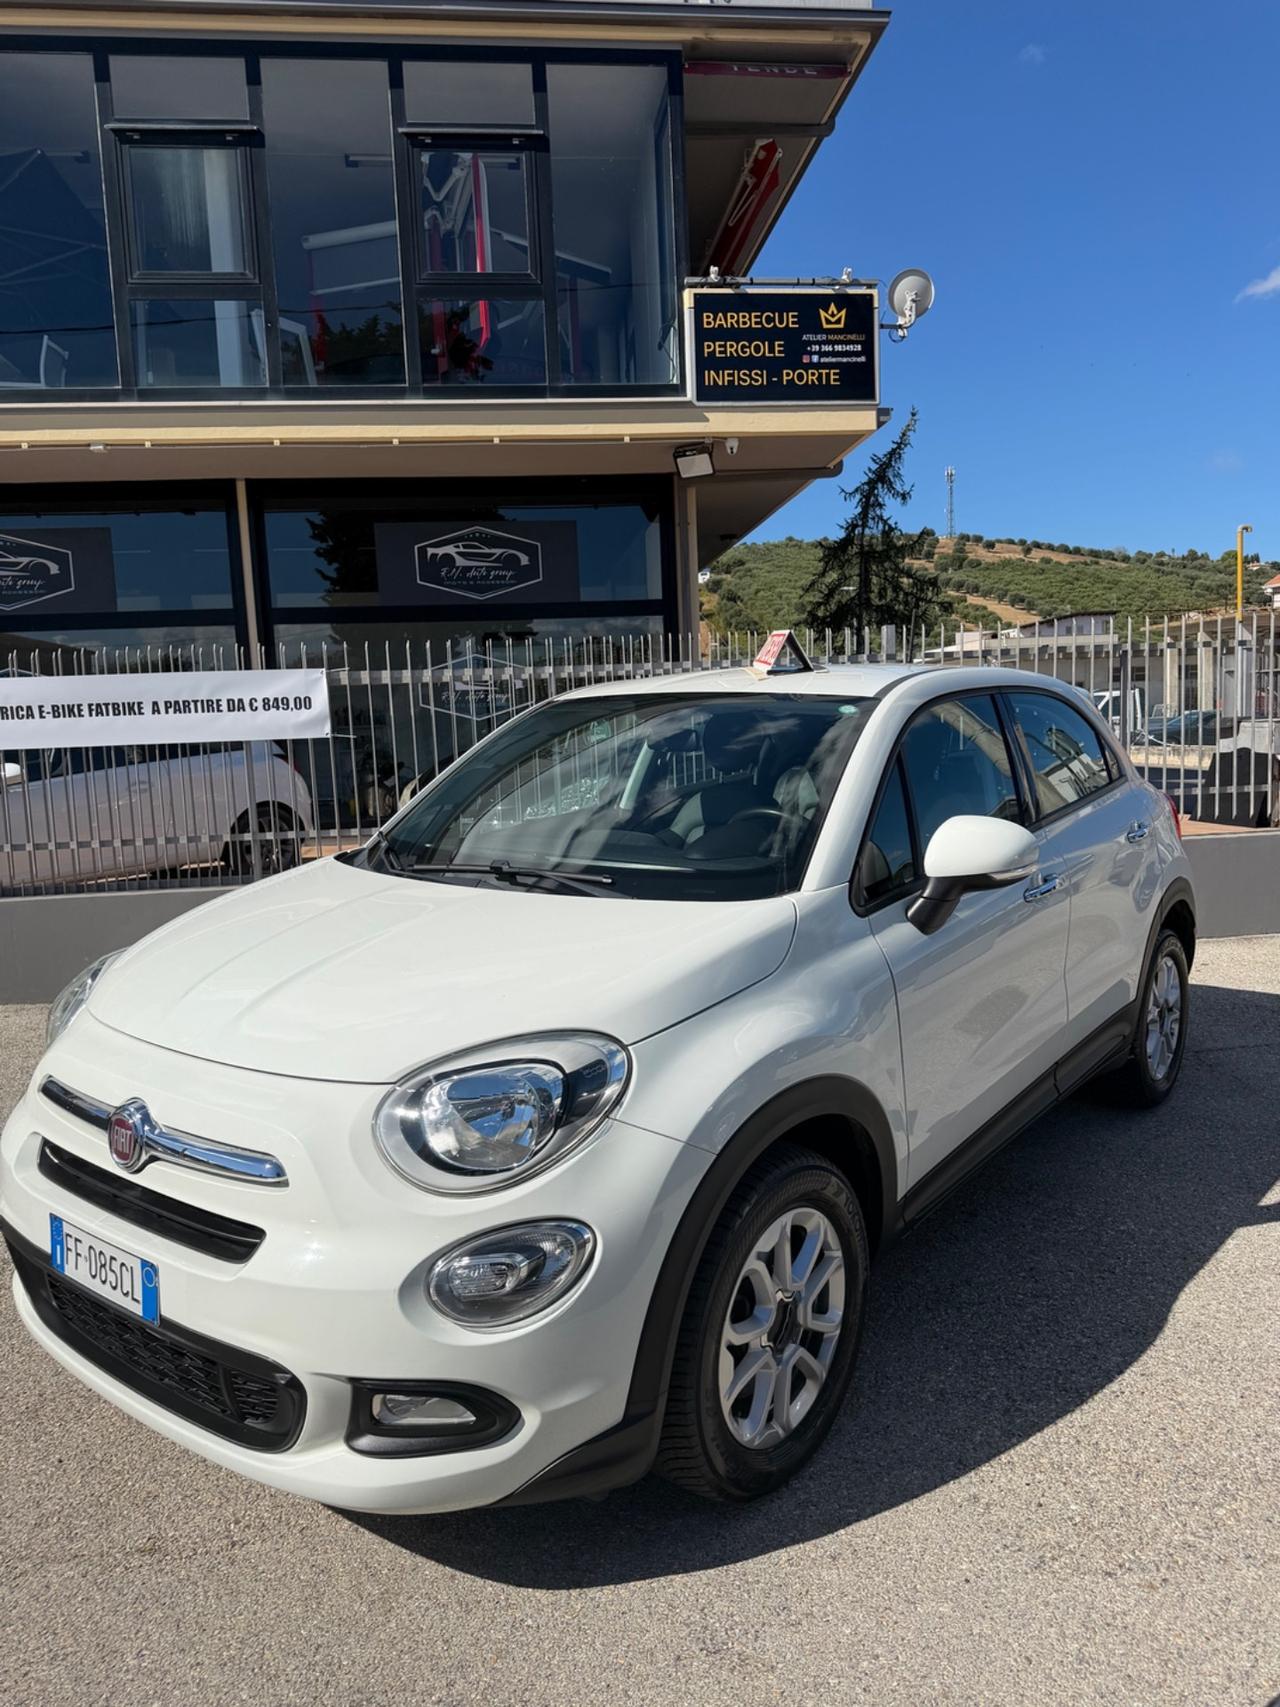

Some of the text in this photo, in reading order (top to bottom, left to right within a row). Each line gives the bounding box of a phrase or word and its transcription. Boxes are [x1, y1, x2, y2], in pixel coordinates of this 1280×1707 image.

[703, 312, 799, 328] BARBECUE
[703, 341, 785, 357] PERGOLE
[704, 370, 767, 386] INFISSI
[782, 369, 841, 385] PORTE
[38, 703, 85, 719] E-BIKE
[87, 701, 145, 717] FATBIKE
[151, 701, 161, 715] A
[164, 698, 224, 714] PARTIRE
[227, 698, 246, 713] DA
[112, 1125, 133, 1154] FIAT
